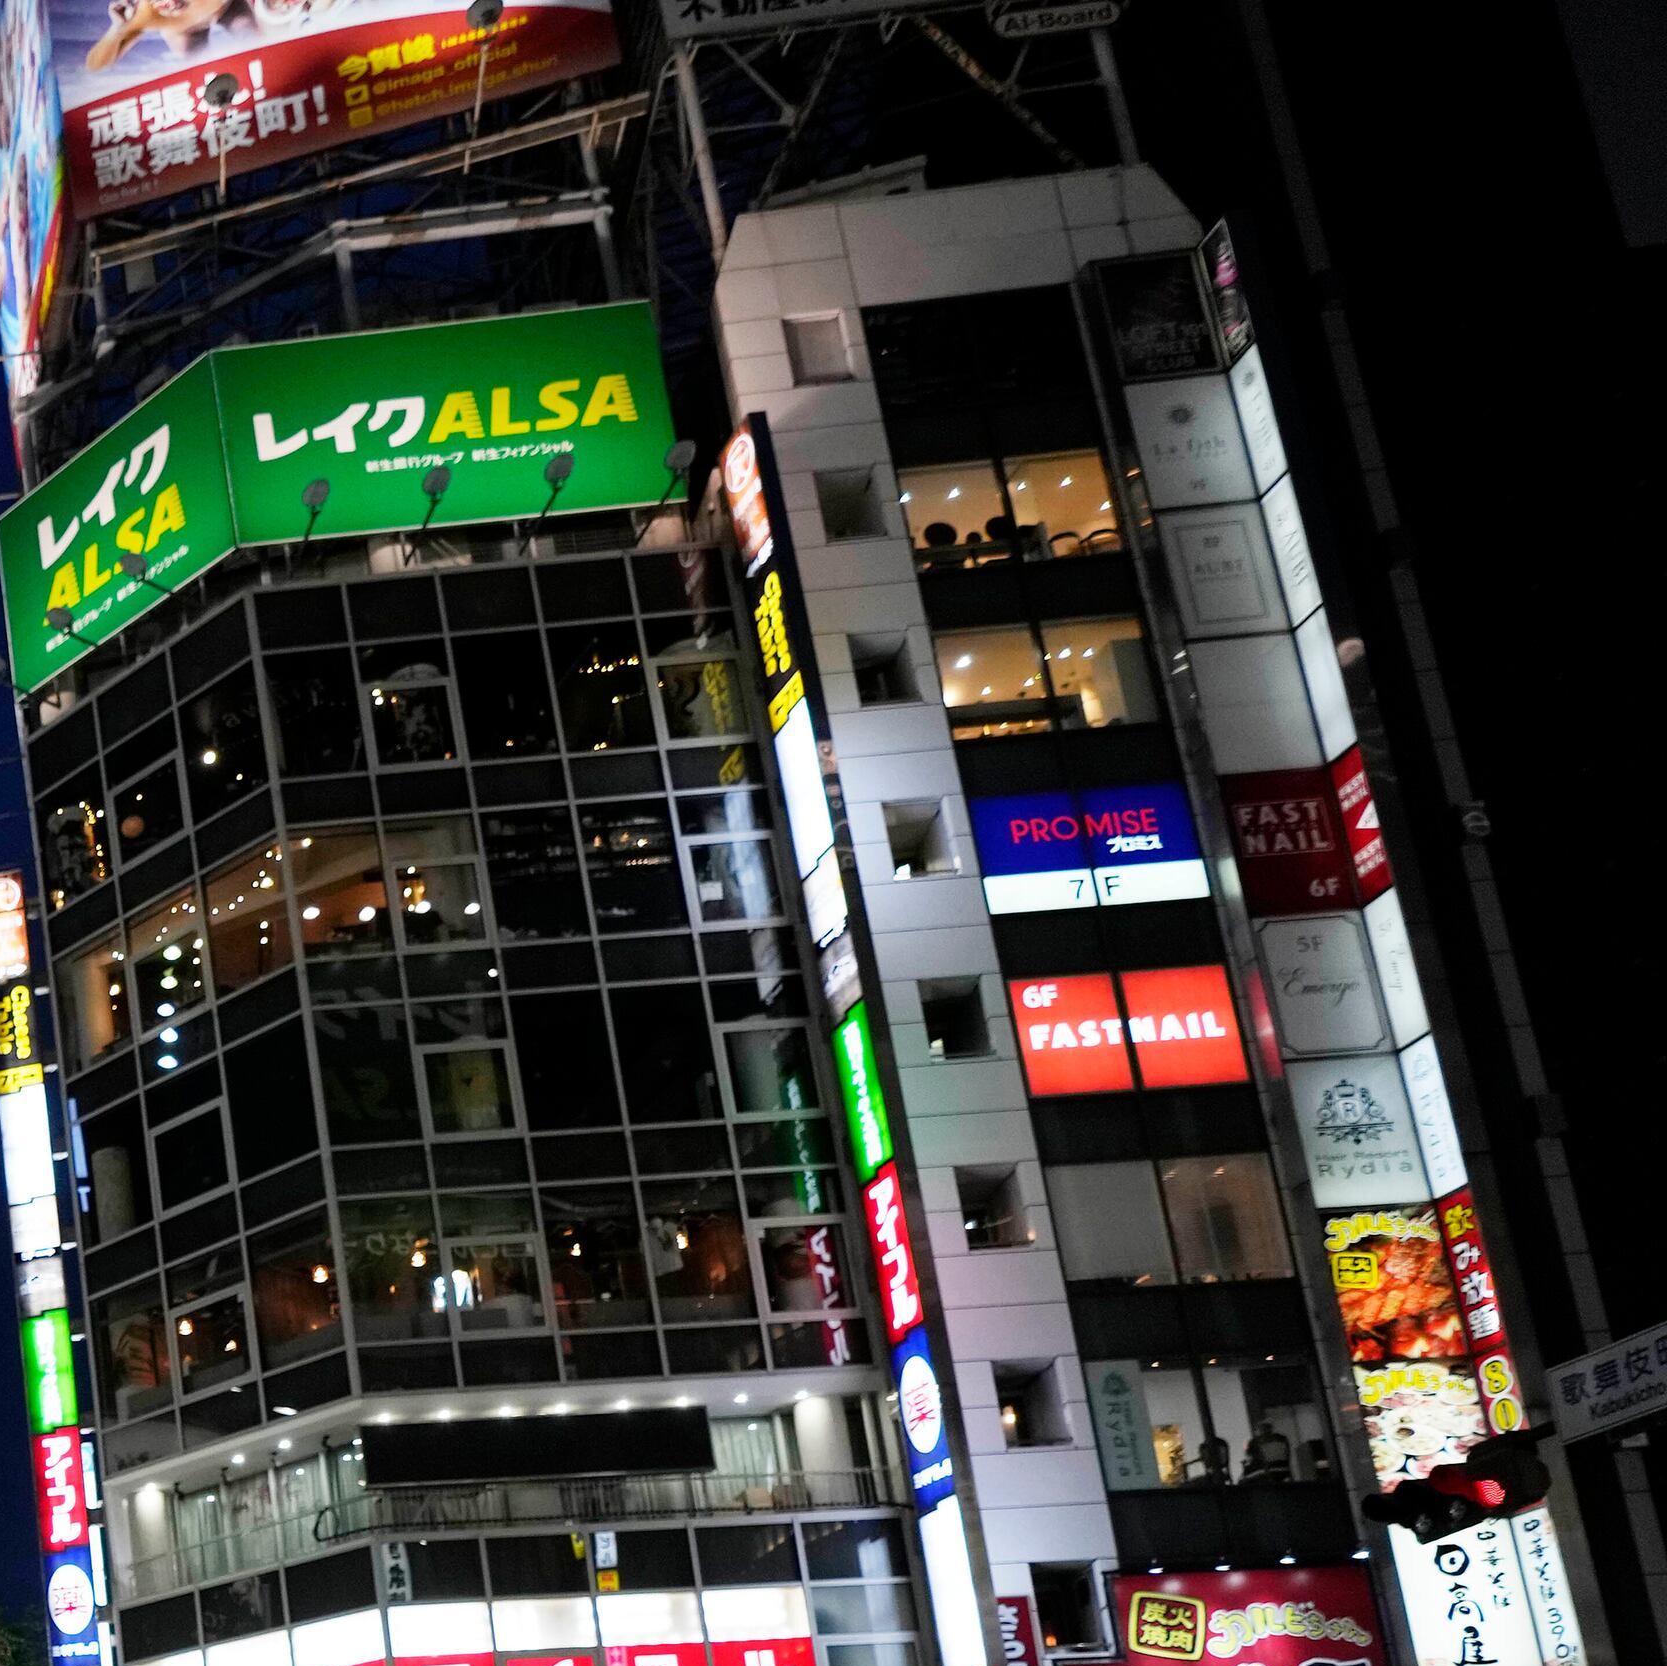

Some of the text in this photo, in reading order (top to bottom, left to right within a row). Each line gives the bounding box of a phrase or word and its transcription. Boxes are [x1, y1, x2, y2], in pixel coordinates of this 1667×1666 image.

[36, 423, 171, 570] レイク
[42, 482, 189, 629] ALSA
[1010, 808, 1159, 844] PROMISE
[1238, 800, 1319, 827] FAST
[1106, 833, 1164, 855] プロミス
[1242, 824, 1333, 855] NAIL
[1309, 876, 1341, 898] 6F
[1297, 935, 1323, 953] 5F
[1022, 984, 1058, 1010] 6F
[1028, 1010, 1226, 1052] FAST NAIL
[1317, 1161, 1414, 1181] Rydia
[868, 1174, 919, 1331] アイフル
[1444, 1203, 1501, 1342] 飲み放題
[905, 1383, 937, 1434] 薬
[39, 1436, 82, 1546] アイフル
[54, 1582, 92, 1631] 薬
[1141, 1602, 1194, 1627] 炭火
